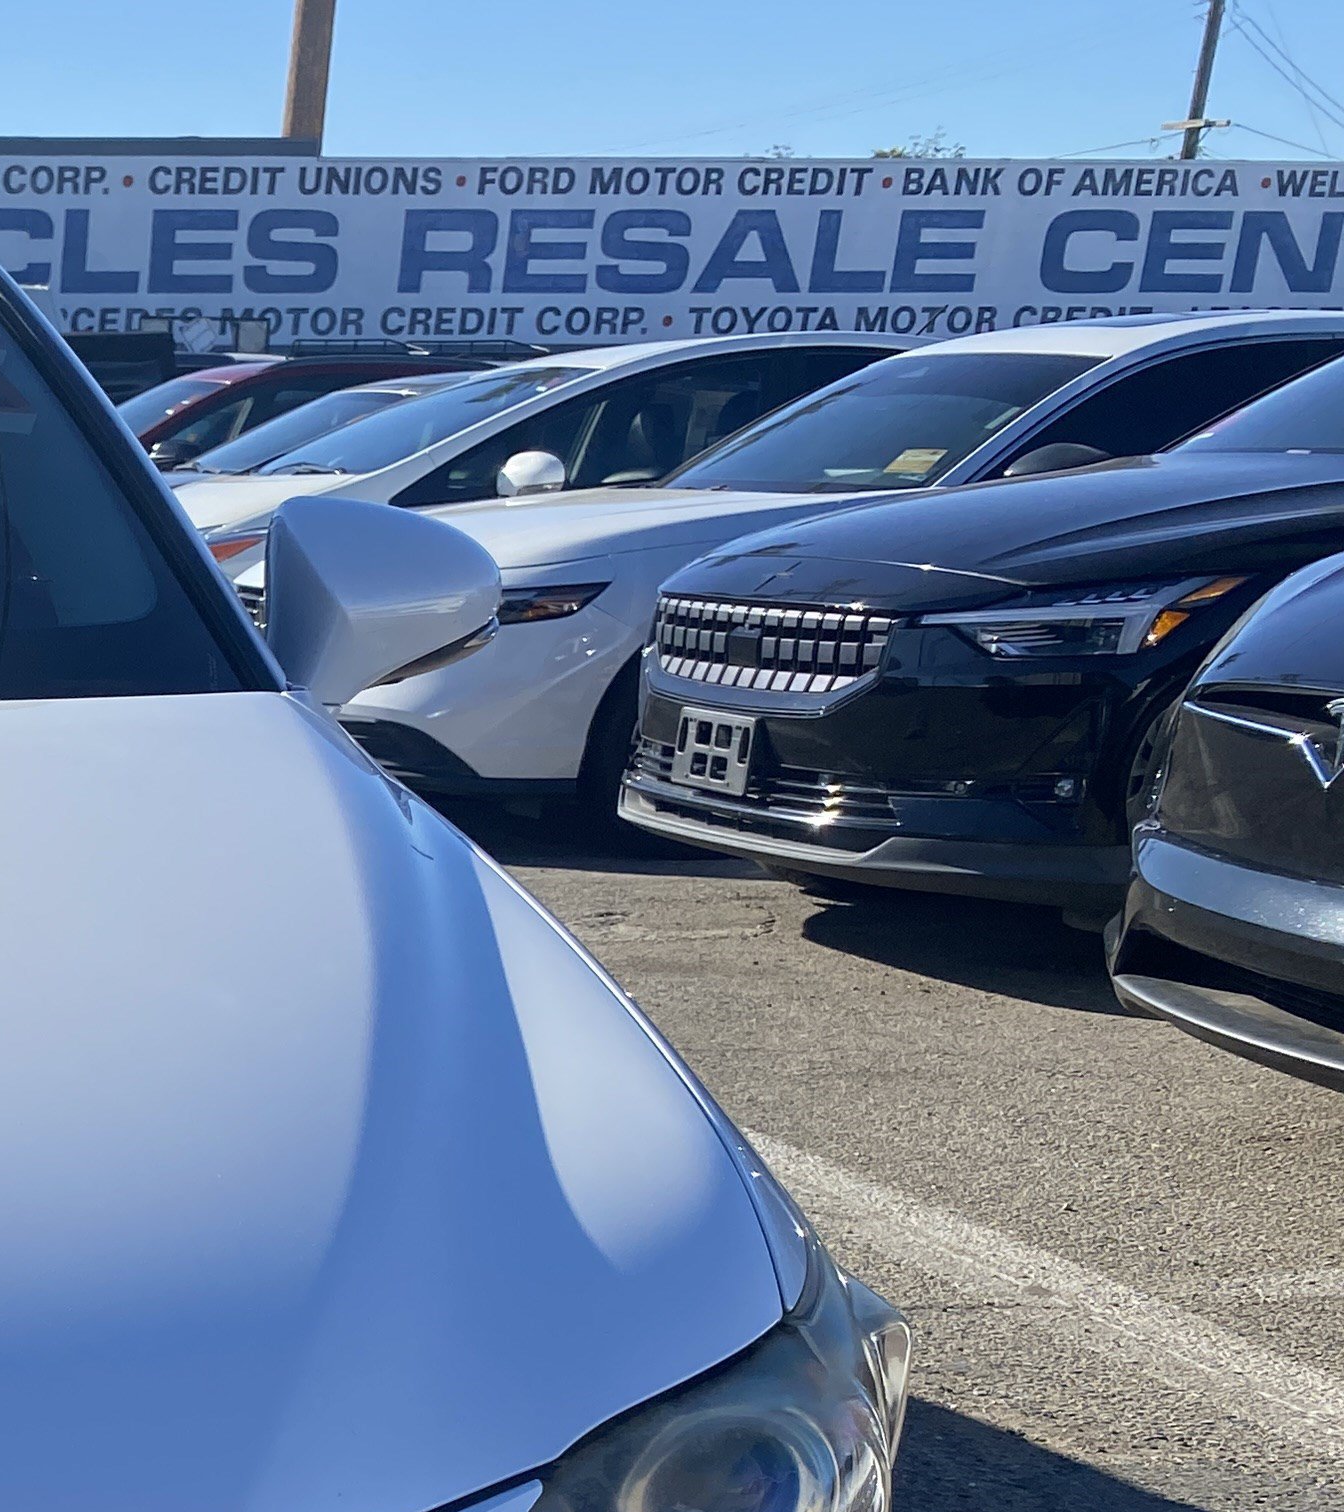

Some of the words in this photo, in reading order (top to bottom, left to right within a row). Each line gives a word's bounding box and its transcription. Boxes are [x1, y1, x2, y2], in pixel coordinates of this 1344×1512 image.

[3, 165, 110, 195] CORP.
[148, 166, 285, 195] CREDIT
[298, 166, 443, 196] UNIONS
[477, 166, 576, 196] FORD
[589, 167, 724, 196] MOTOR
[737, 167, 874, 197] CREDIT
[902, 167, 1004, 197] BANK
[1018, 167, 1065, 197] OF
[1072, 168, 1239, 197] AMERICA
[1277, 169, 1344, 198] WEL
[397, 208, 985, 294] RESALE
[1039, 208, 1344, 294] CEN
[60, 307, 203, 333] CED
[380, 307, 523, 336] CREDIT
[536, 307, 648, 336] CORP.
[689, 306, 839, 334] TOYOTA
[855, 306, 997, 334] MOTOR
[1013, 306, 1153, 328] CRE
